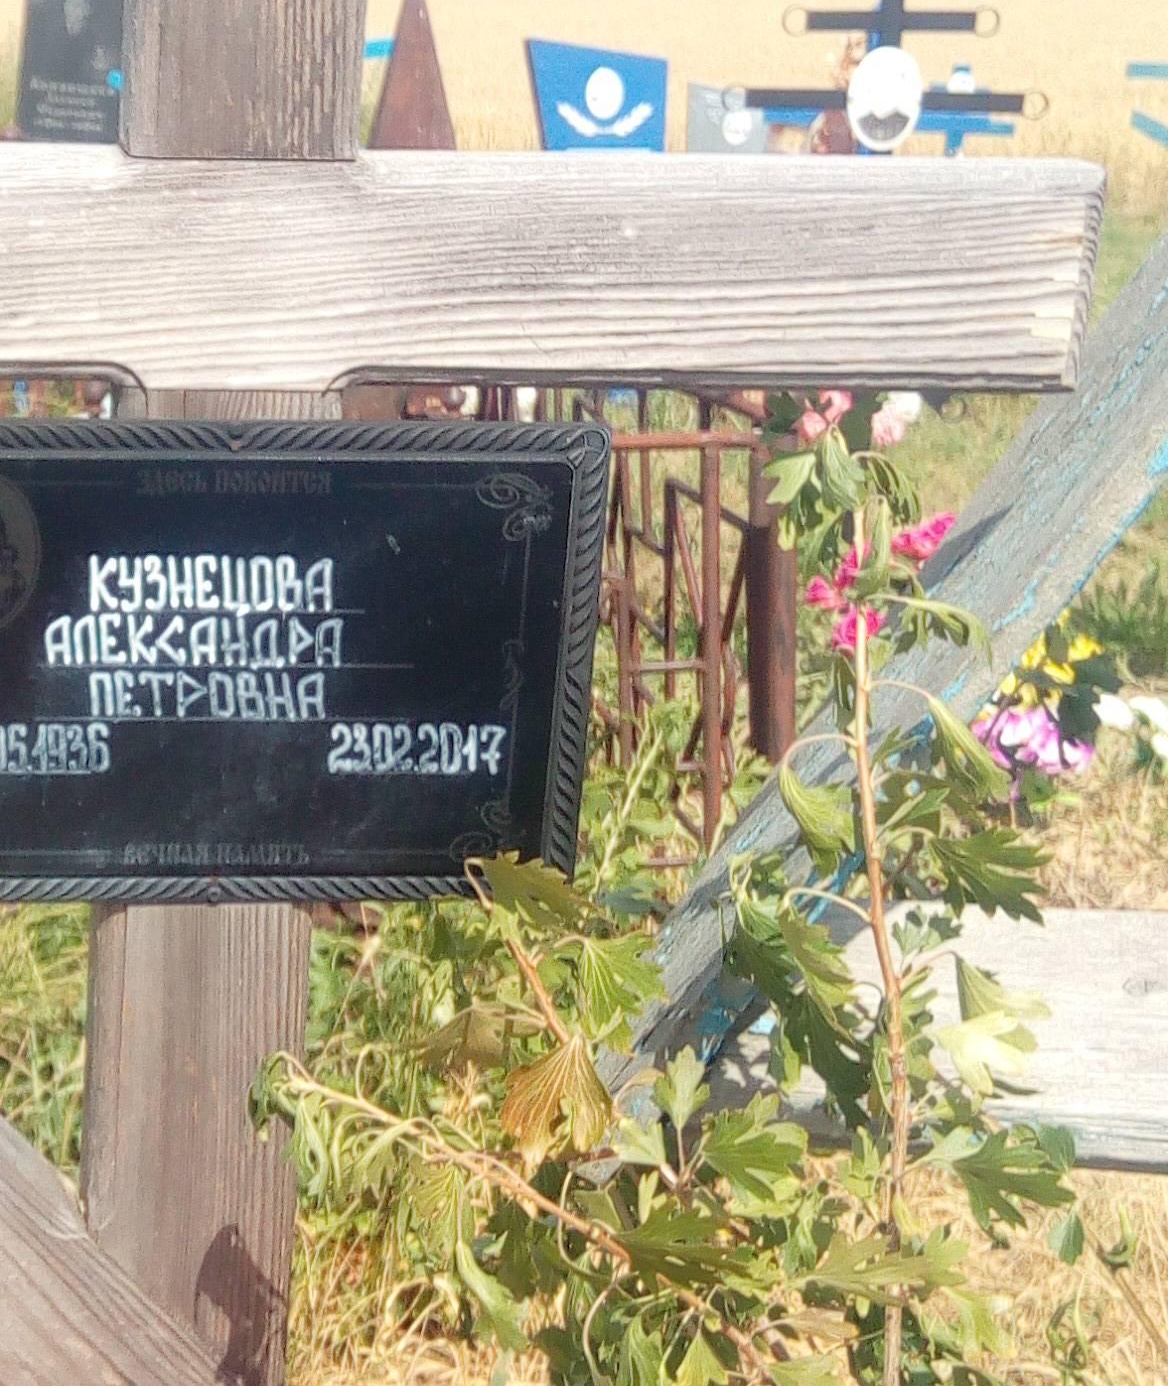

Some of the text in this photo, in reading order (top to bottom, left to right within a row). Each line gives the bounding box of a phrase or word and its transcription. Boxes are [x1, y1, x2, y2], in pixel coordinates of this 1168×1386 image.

[89, 554, 333, 617] КУЗНЕЦОВА
[44, 613, 343, 669] АЛЕКСАНДРА
[89, 670, 326, 721] ПЕТРОВНА
